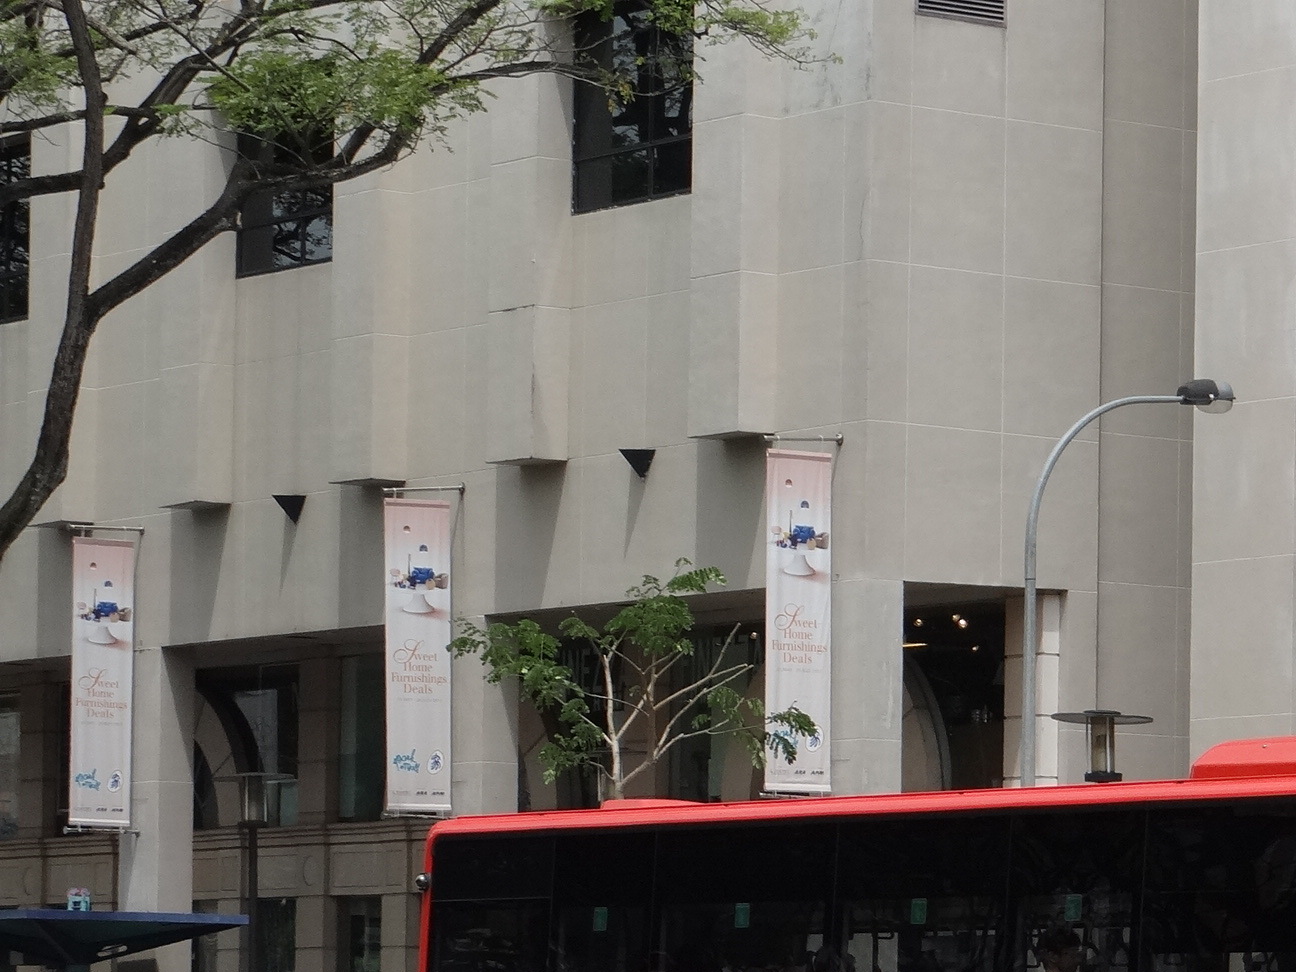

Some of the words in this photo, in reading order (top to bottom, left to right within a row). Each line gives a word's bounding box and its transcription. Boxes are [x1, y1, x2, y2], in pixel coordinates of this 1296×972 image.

[774, 603, 818, 630] Sweet
[783, 628, 813, 640] Home
[393, 639, 438, 664] Sweet
[772, 640, 828, 655] Furnishings
[783, 653, 812, 664] Deals
[403, 662, 433, 672] Home
[391, 672, 448, 686] Furnishings
[403, 684, 433, 694] Deals
[86, 708, 115, 718] Deals
